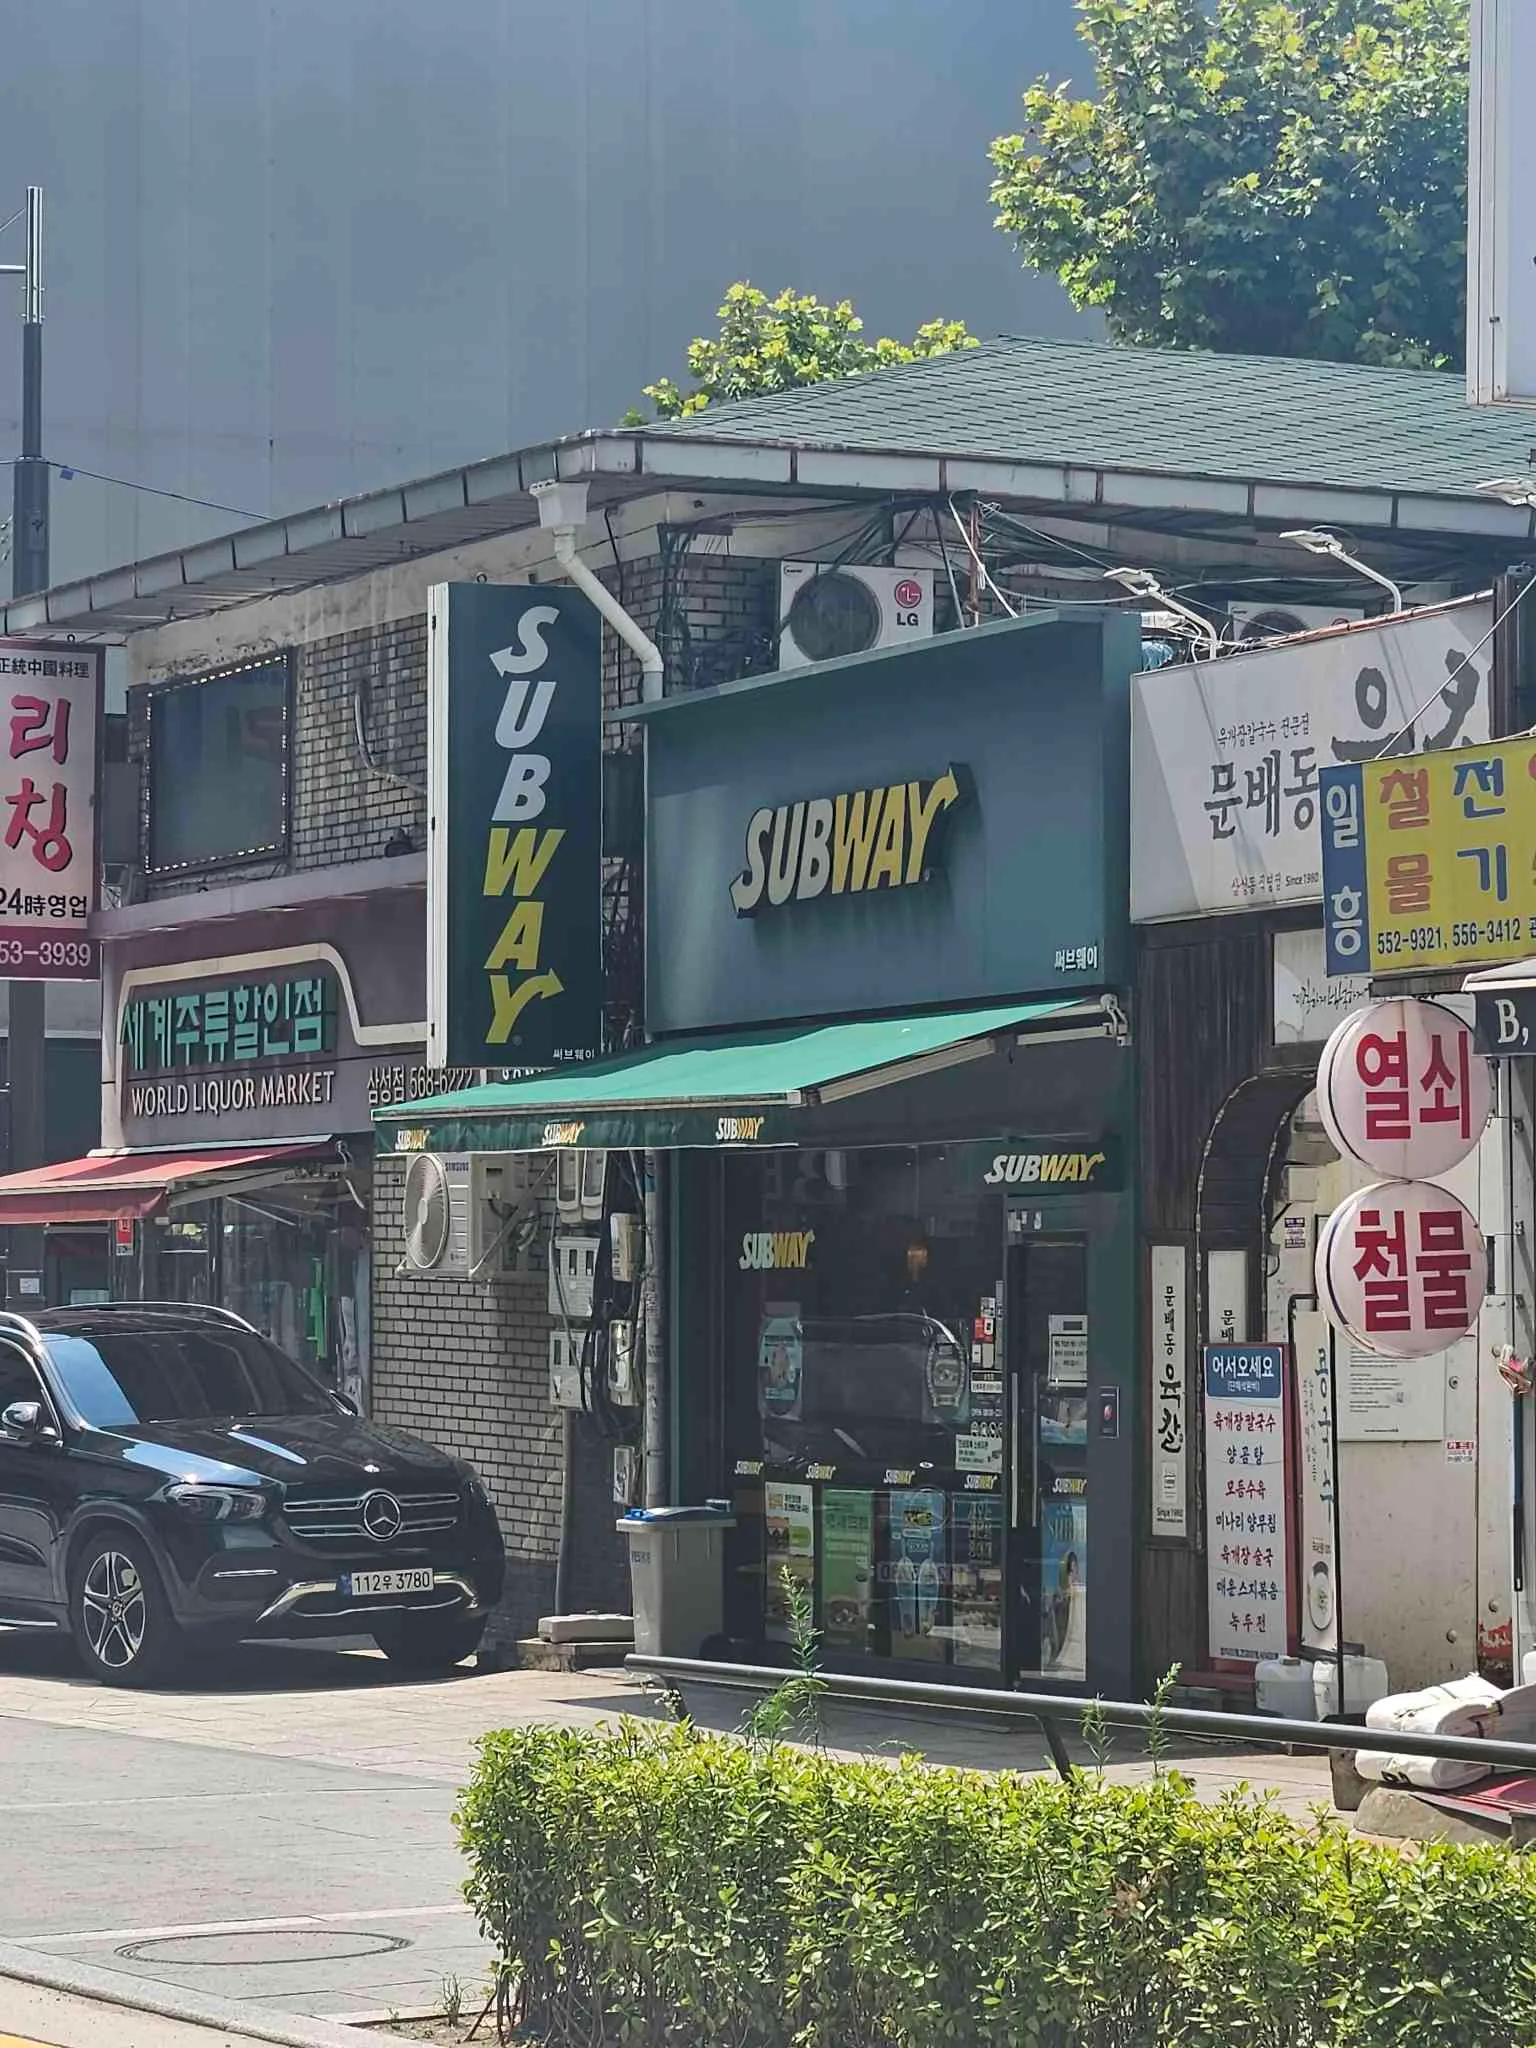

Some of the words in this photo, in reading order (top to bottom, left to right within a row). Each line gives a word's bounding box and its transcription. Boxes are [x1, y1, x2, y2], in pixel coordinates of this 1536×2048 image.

[896, 612, 919, 626] LG
[1203, 747, 1320, 840] 문배동
[484, 604, 567, 1044] SUBWAY
[729, 767, 961, 914] SUBWAY
[1379, 768, 1433, 914] 철물
[1453, 757, 1507, 902] 전기
[1325, 784, 1363, 956] 일흥
[1452, 917, 1521, 947] 556-3412
[121, 977, 324, 1071] 세계주류할인점
[132, 1084, 189, 1117] WORLD
[193, 1078, 255, 1115] LIQUOR
[261, 1071, 335, 1105] MARKET
[367, 1064, 405, 1105] 삼성점
[1356, 1030, 1471, 1140] 열쇠
[395, 1128, 431, 1150] SUBWAY
[542, 1120, 585, 1146] SUBWAY
[715, 1116, 765, 1141] SUBWAY
[984, 1152, 1106, 1184] SUBWAY
[738, 1229, 815, 1270] SUBWAY
[1353, 1210, 1472, 1332] 철물
[1212, 1355, 1274, 1379] 어서오세요
[1213, 1411, 1277, 1433] 육개장칼국수
[1225, 1479, 1267, 1500] 모듬수육
[396, 1571, 430, 1590] 3780
